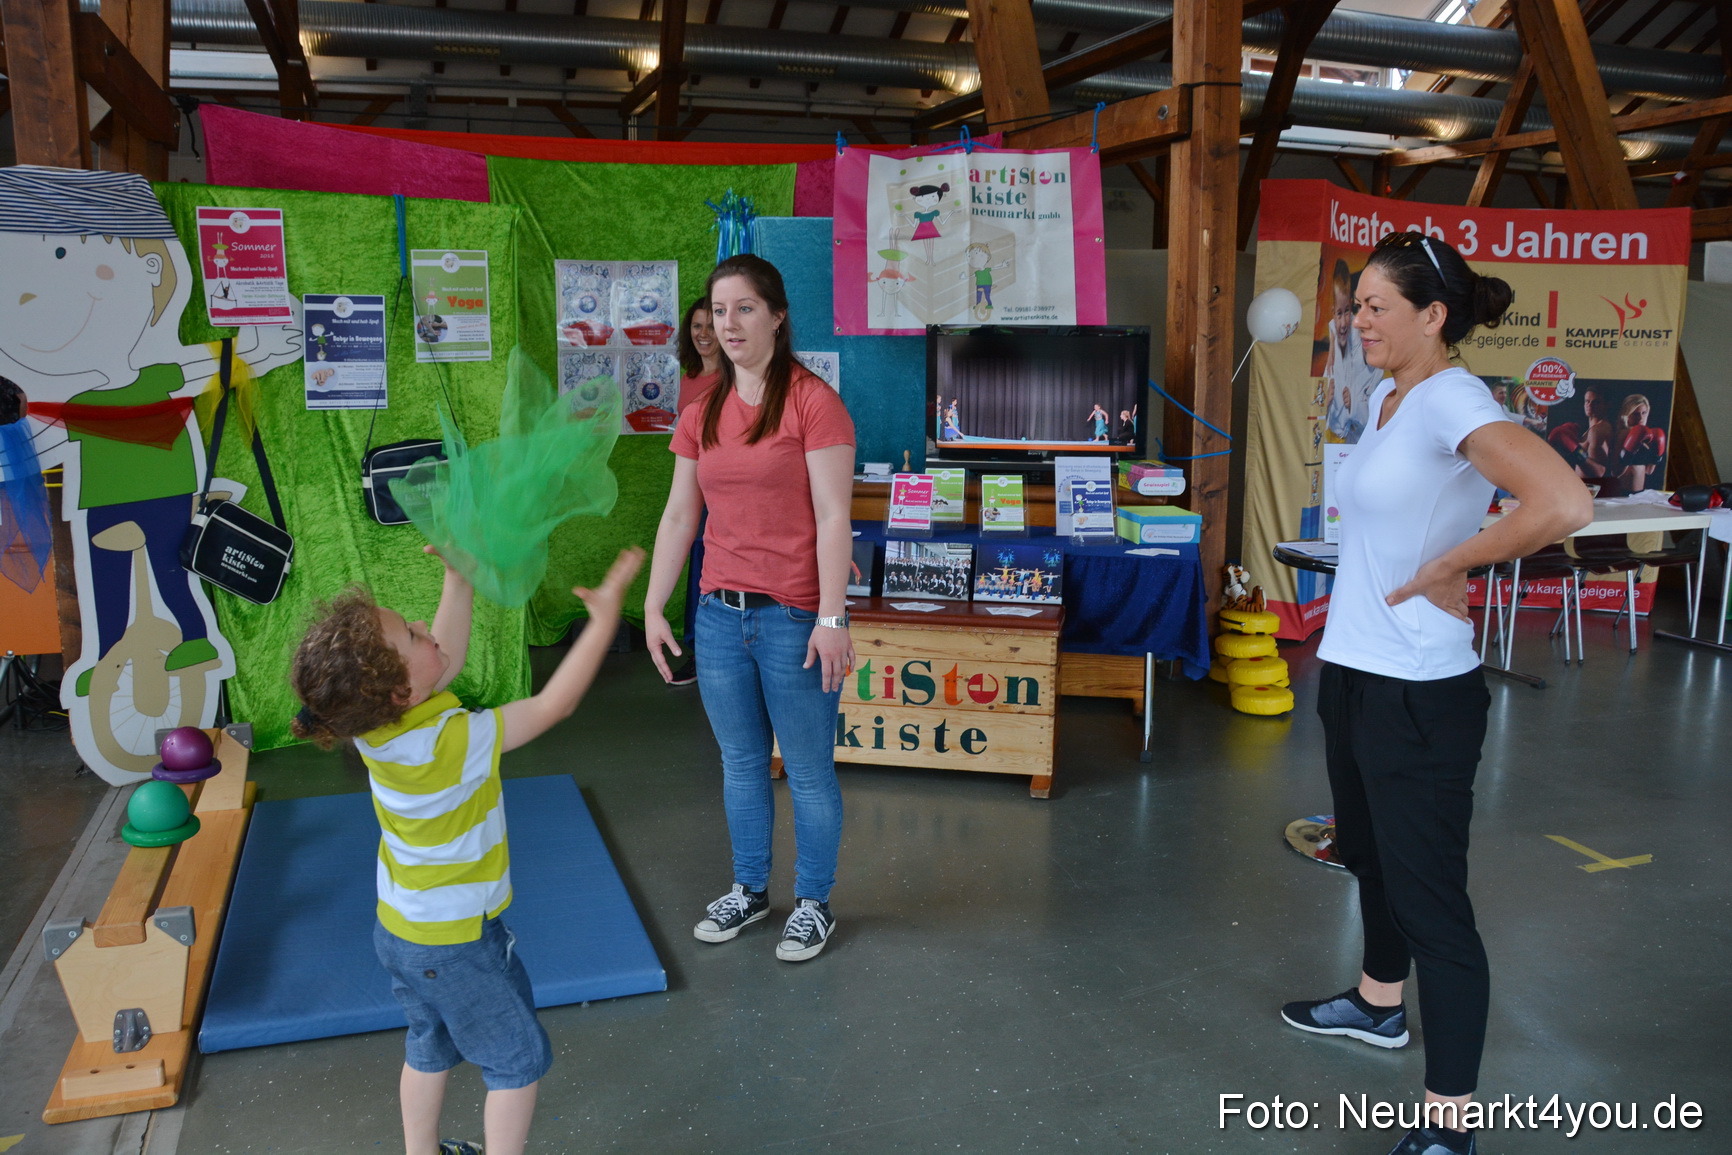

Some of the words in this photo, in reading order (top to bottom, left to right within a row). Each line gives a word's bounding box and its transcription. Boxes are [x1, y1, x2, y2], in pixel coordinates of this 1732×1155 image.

[972, 186, 1027, 206] kiste
[972, 207, 1035, 220] neumarkt
[1038, 212, 1060, 220] gmbh
[1330, 199, 1394, 248] Karate
[1457, 219, 1478, 256] 3
[1492, 221, 1648, 260] Jahren
[231, 242, 276, 252] Sommer
[447, 296, 484, 310] Yoga
[1502, 312, 1540, 327] Kind
[1565, 339, 1618, 349] SCHULE
[1537, 365, 1563, 373] 100%
[222, 553, 246, 570] kiste
[221, 562, 248, 579] neumarkt
[834, 712, 988, 755] kiste
